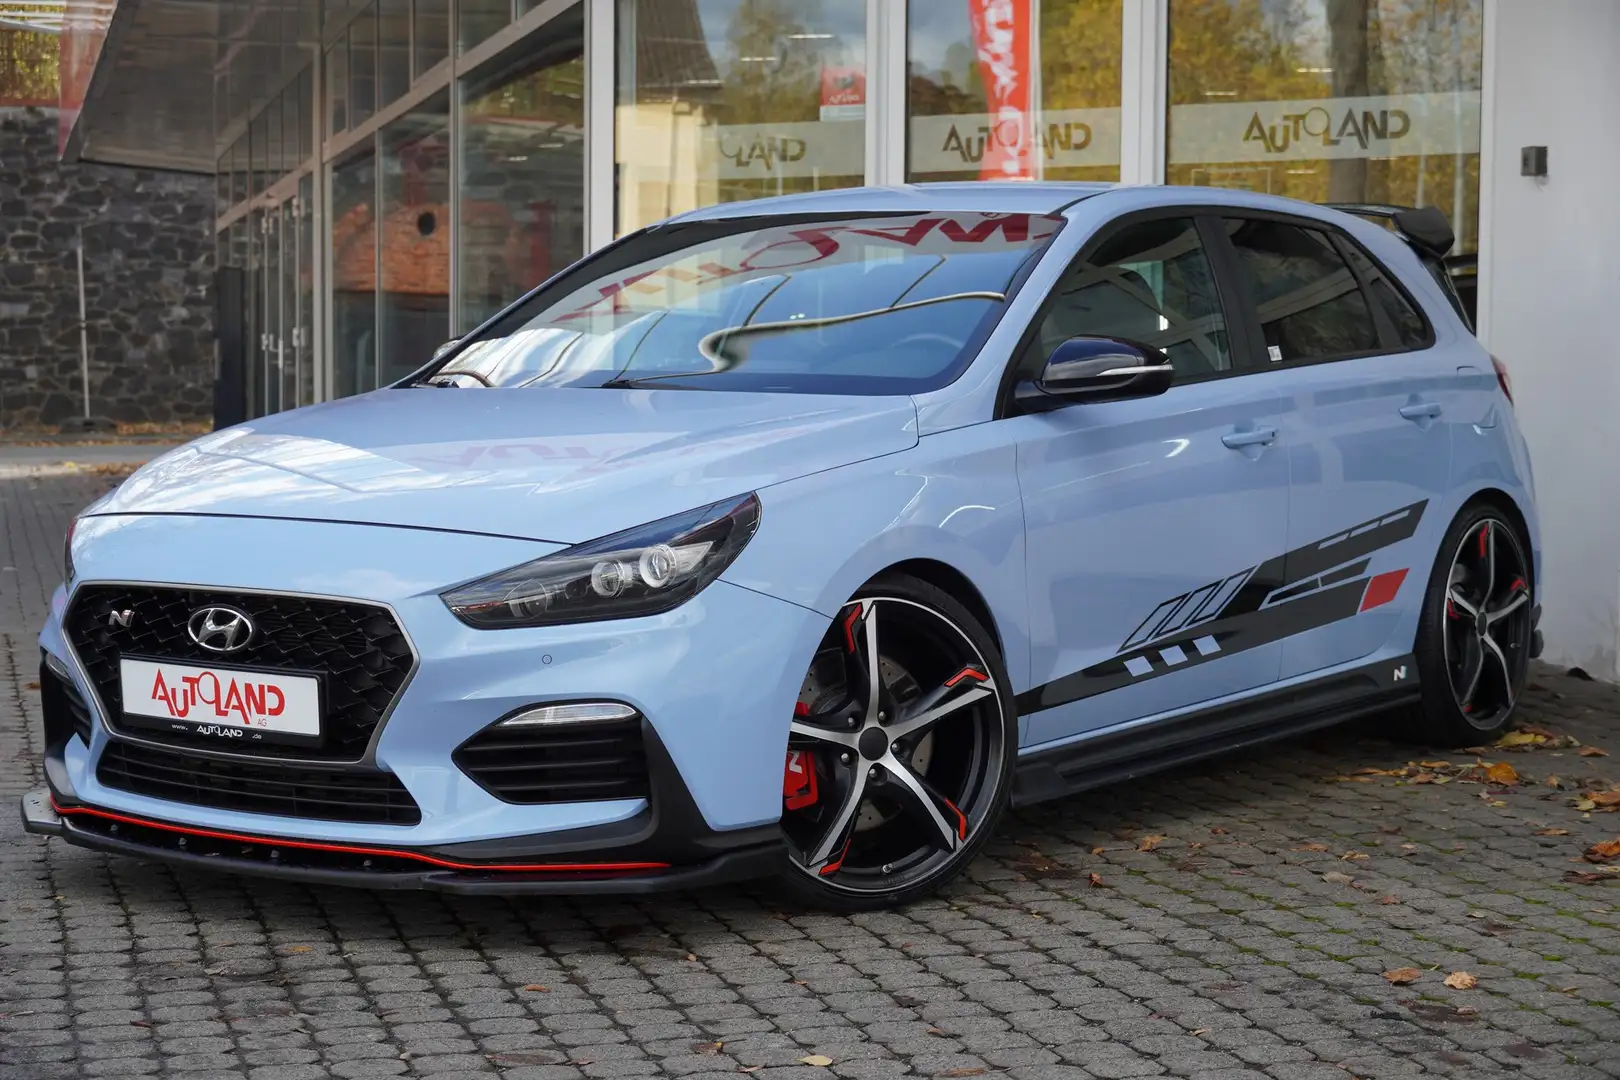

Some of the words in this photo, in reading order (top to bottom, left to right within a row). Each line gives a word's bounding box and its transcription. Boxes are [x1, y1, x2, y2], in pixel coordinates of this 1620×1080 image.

[1243, 106, 1411, 153] AUTOLAND
[108, 609, 135, 628] N
[1393, 665, 1407, 681] N
[152, 668, 286, 725] AUTOLAND
[171, 723, 188, 731] www.
[196, 724, 243, 737] AUTOLAND
[257, 718, 267, 727] AG
